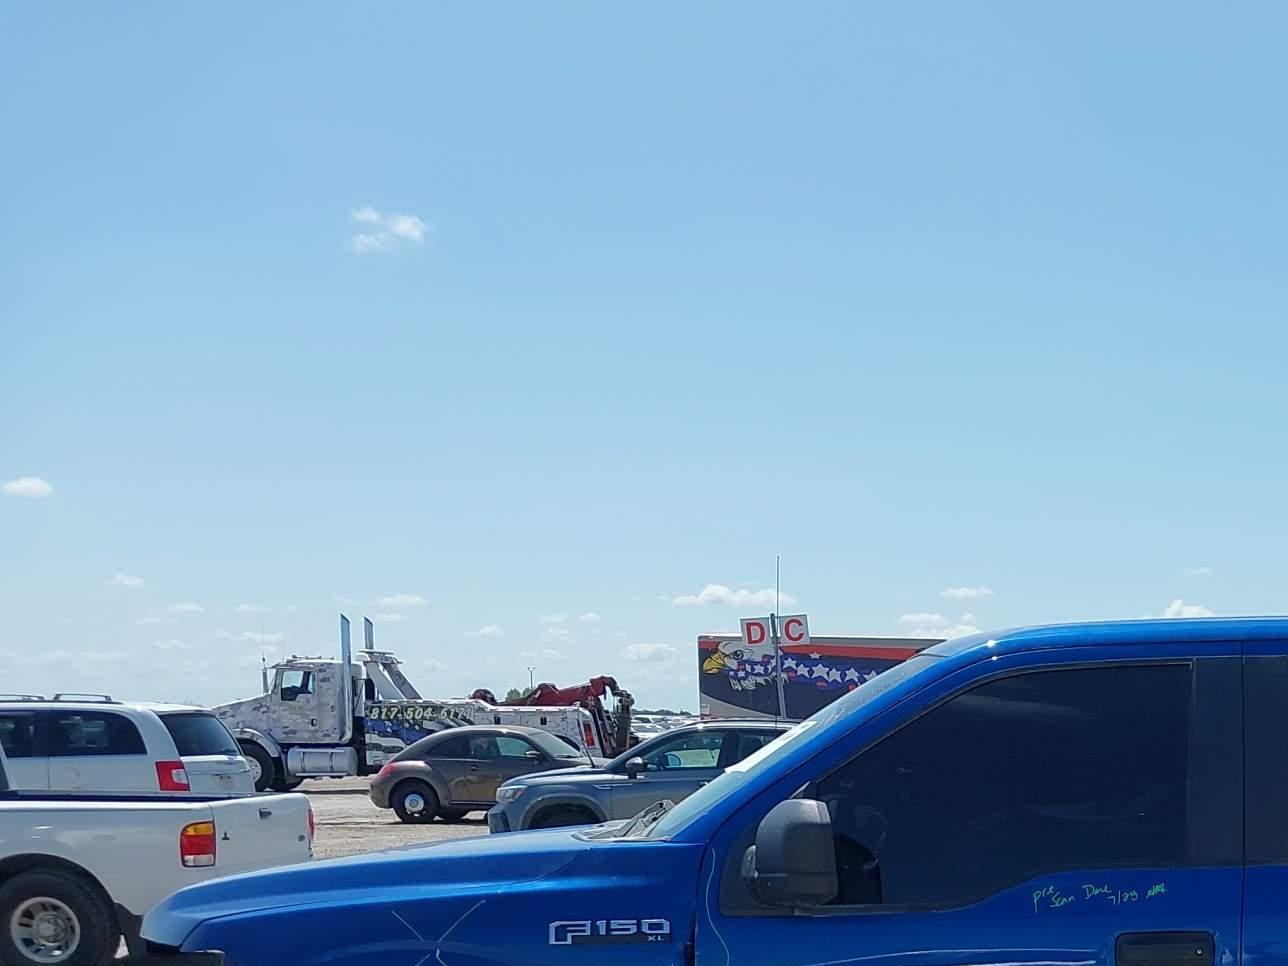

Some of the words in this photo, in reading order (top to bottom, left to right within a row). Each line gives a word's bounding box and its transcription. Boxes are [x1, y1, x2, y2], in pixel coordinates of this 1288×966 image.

[745, 622, 766, 645] D
[784, 618, 805, 642] C
[548, 918, 670, 944] F150
